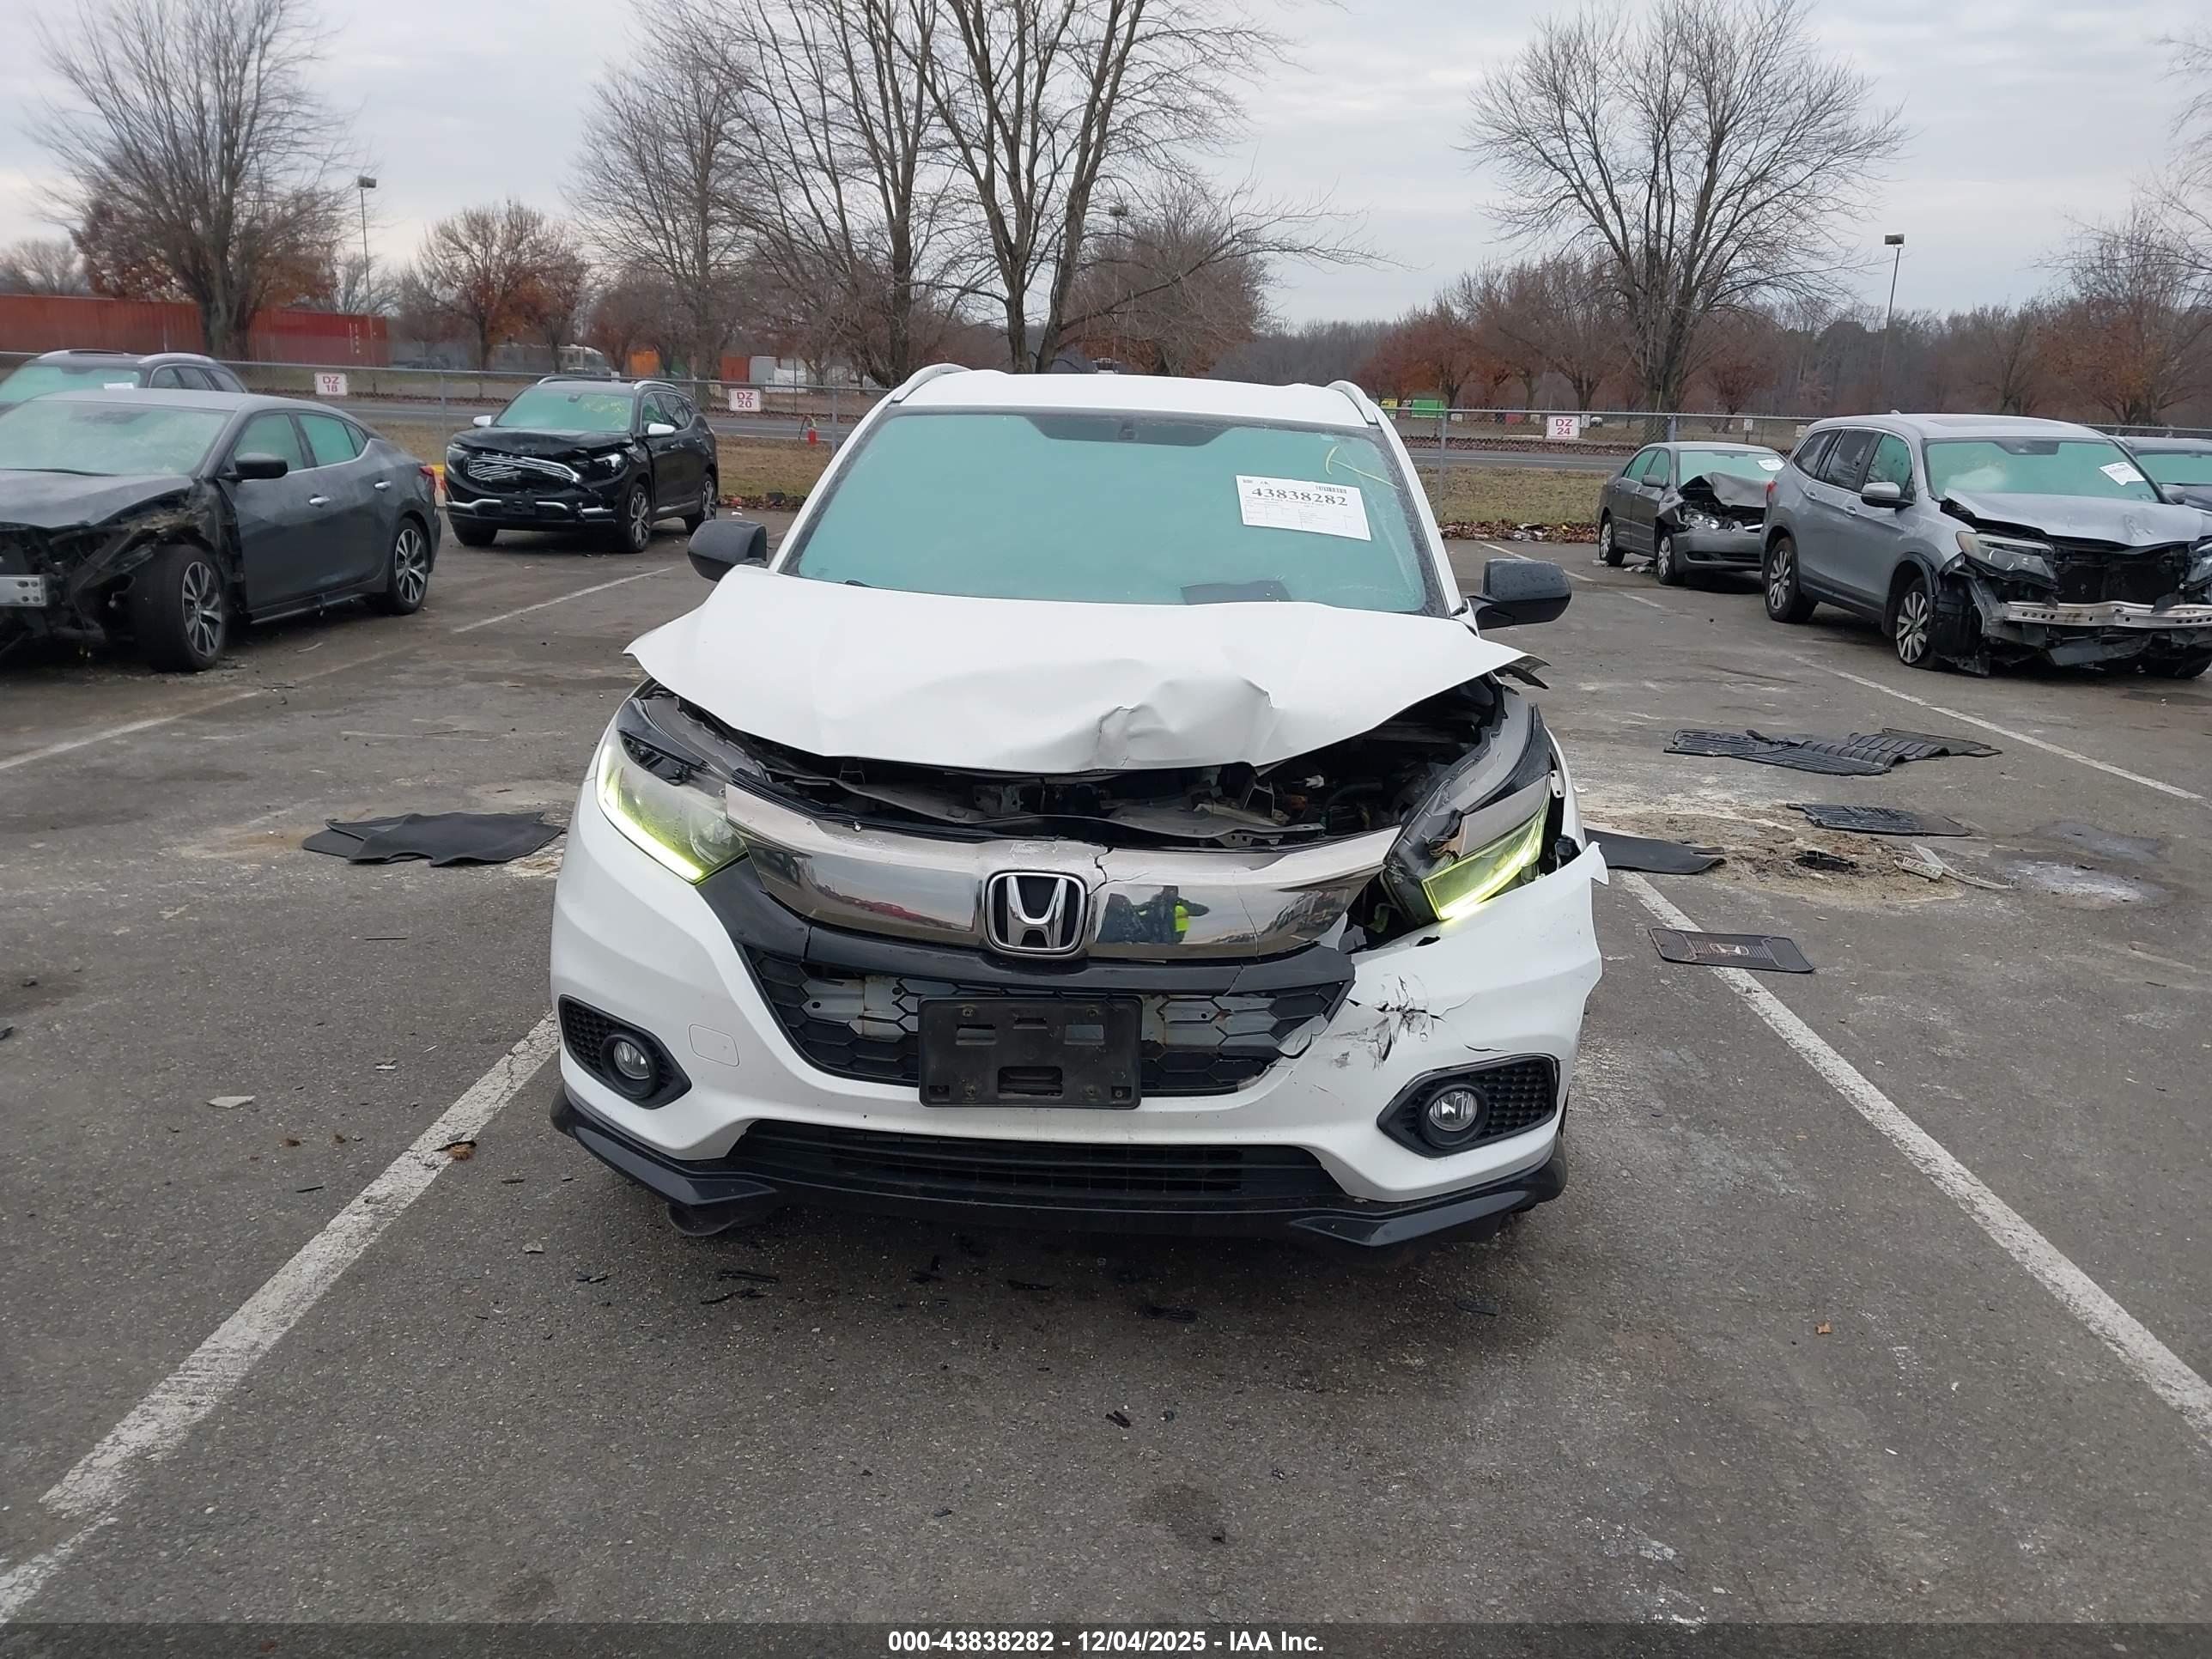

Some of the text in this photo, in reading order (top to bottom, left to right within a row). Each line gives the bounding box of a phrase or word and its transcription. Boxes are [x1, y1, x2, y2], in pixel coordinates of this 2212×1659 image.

[737, 392, 754, 400] DZ
[738, 400, 752, 409] 20
[1555, 418, 1573, 427] DZ
[1557, 427, 1571, 435] 24
[1252, 488, 1347, 507] 43838282
